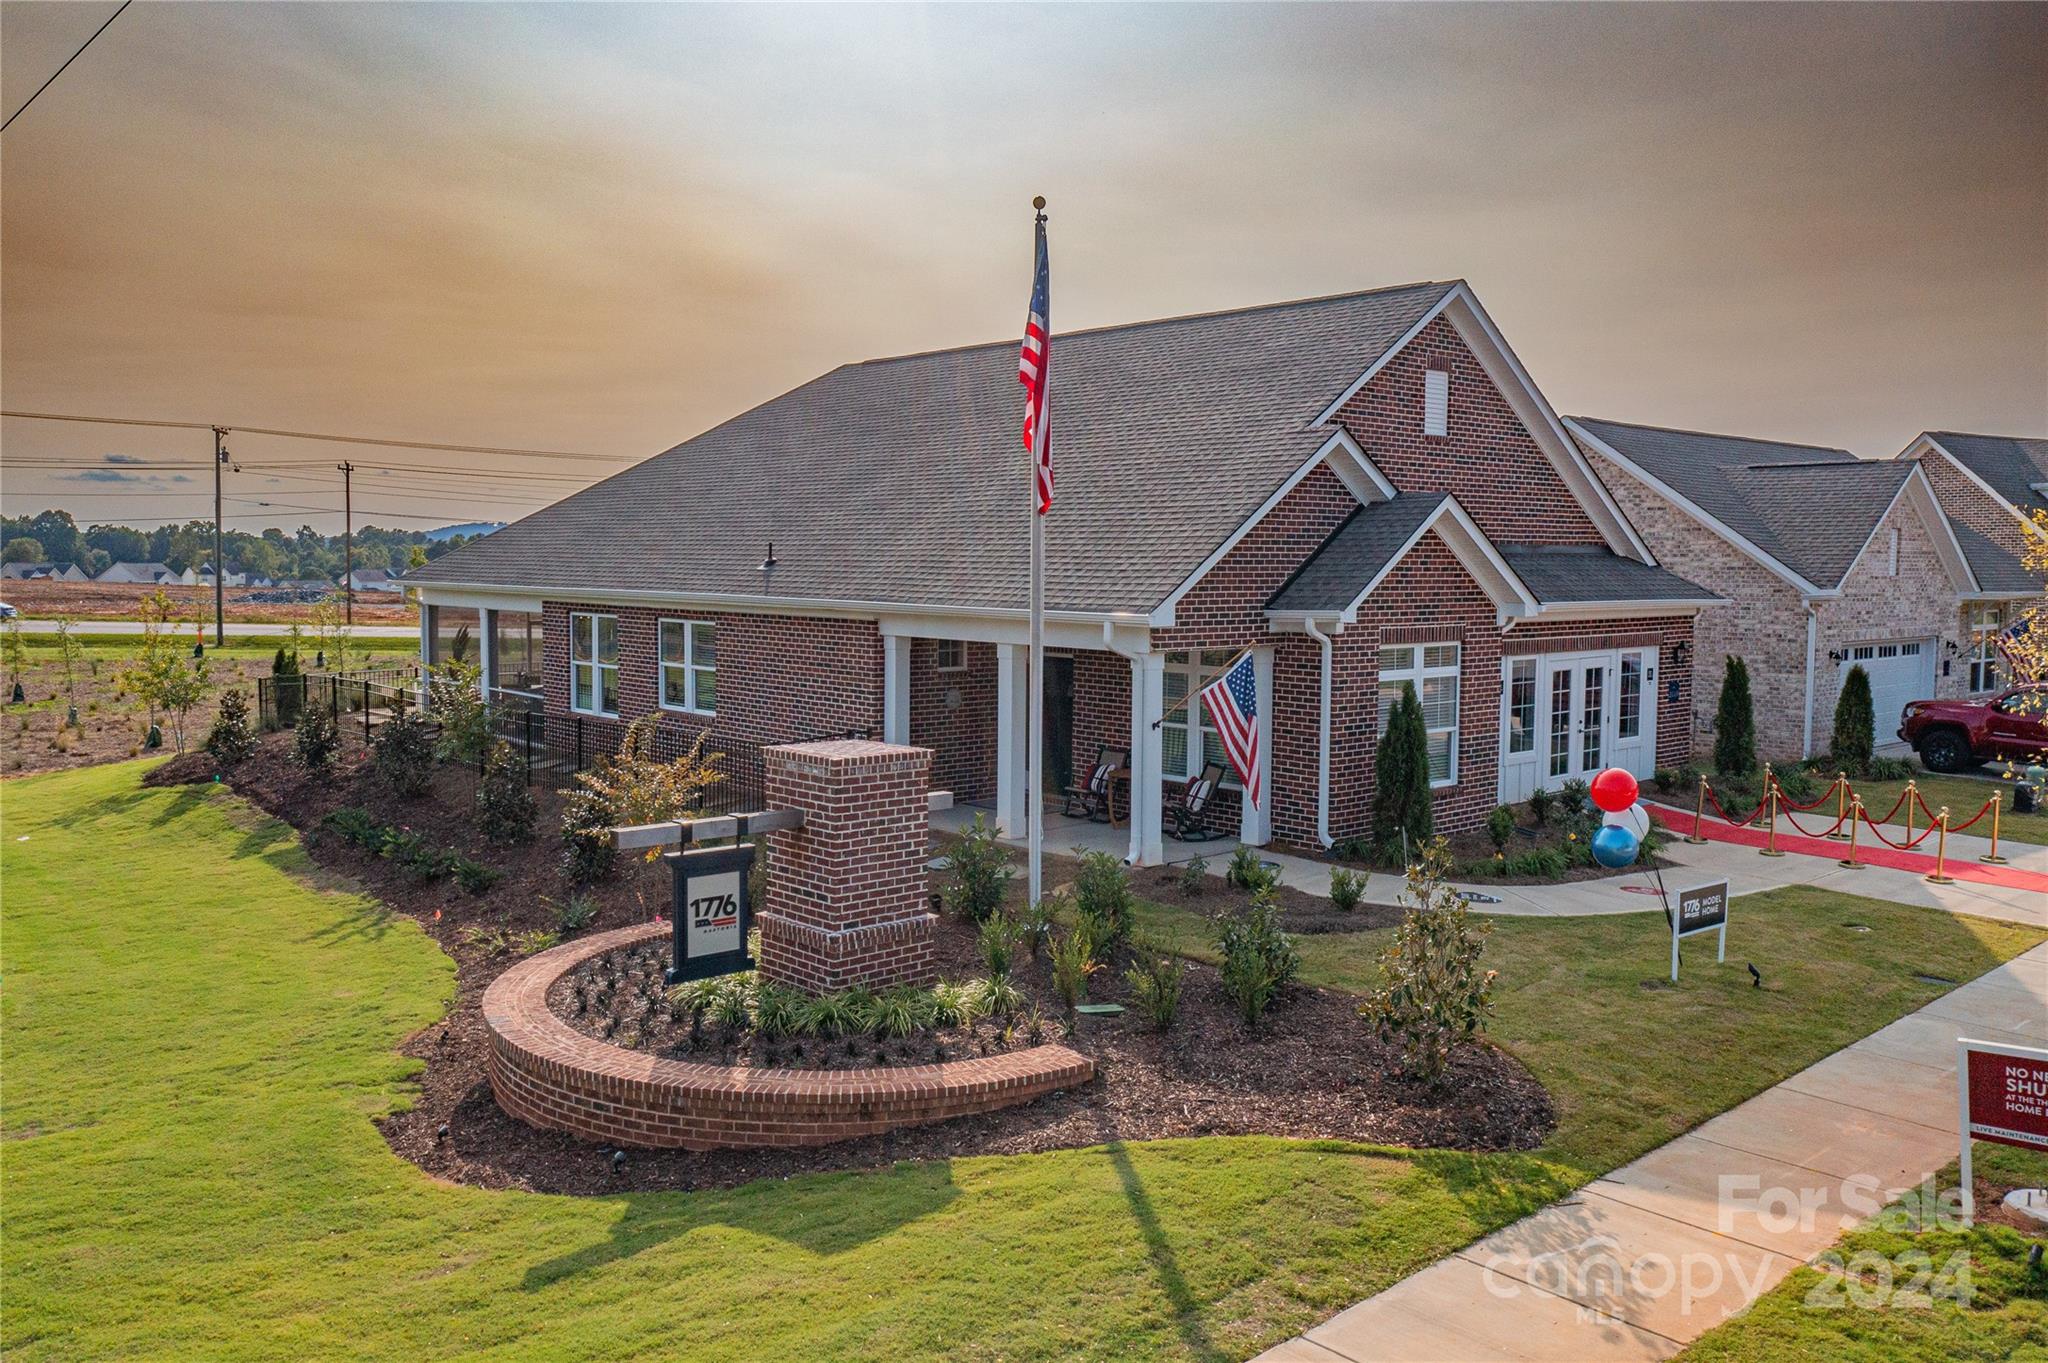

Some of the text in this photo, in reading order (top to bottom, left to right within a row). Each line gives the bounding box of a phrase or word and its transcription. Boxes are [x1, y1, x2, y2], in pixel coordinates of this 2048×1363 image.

[690, 893, 737, 918] 1776
[1684, 899, 1700, 912] 1776
[1702, 895, 1721, 905] MODEL
[1702, 904, 1719, 916] HOME
[2006, 1066, 2028, 1078] NO
[2006, 1079, 2048, 1096] SHU
[2018, 1096, 2035, 1104] THE
[2006, 1102, 2042, 1115] HOME
